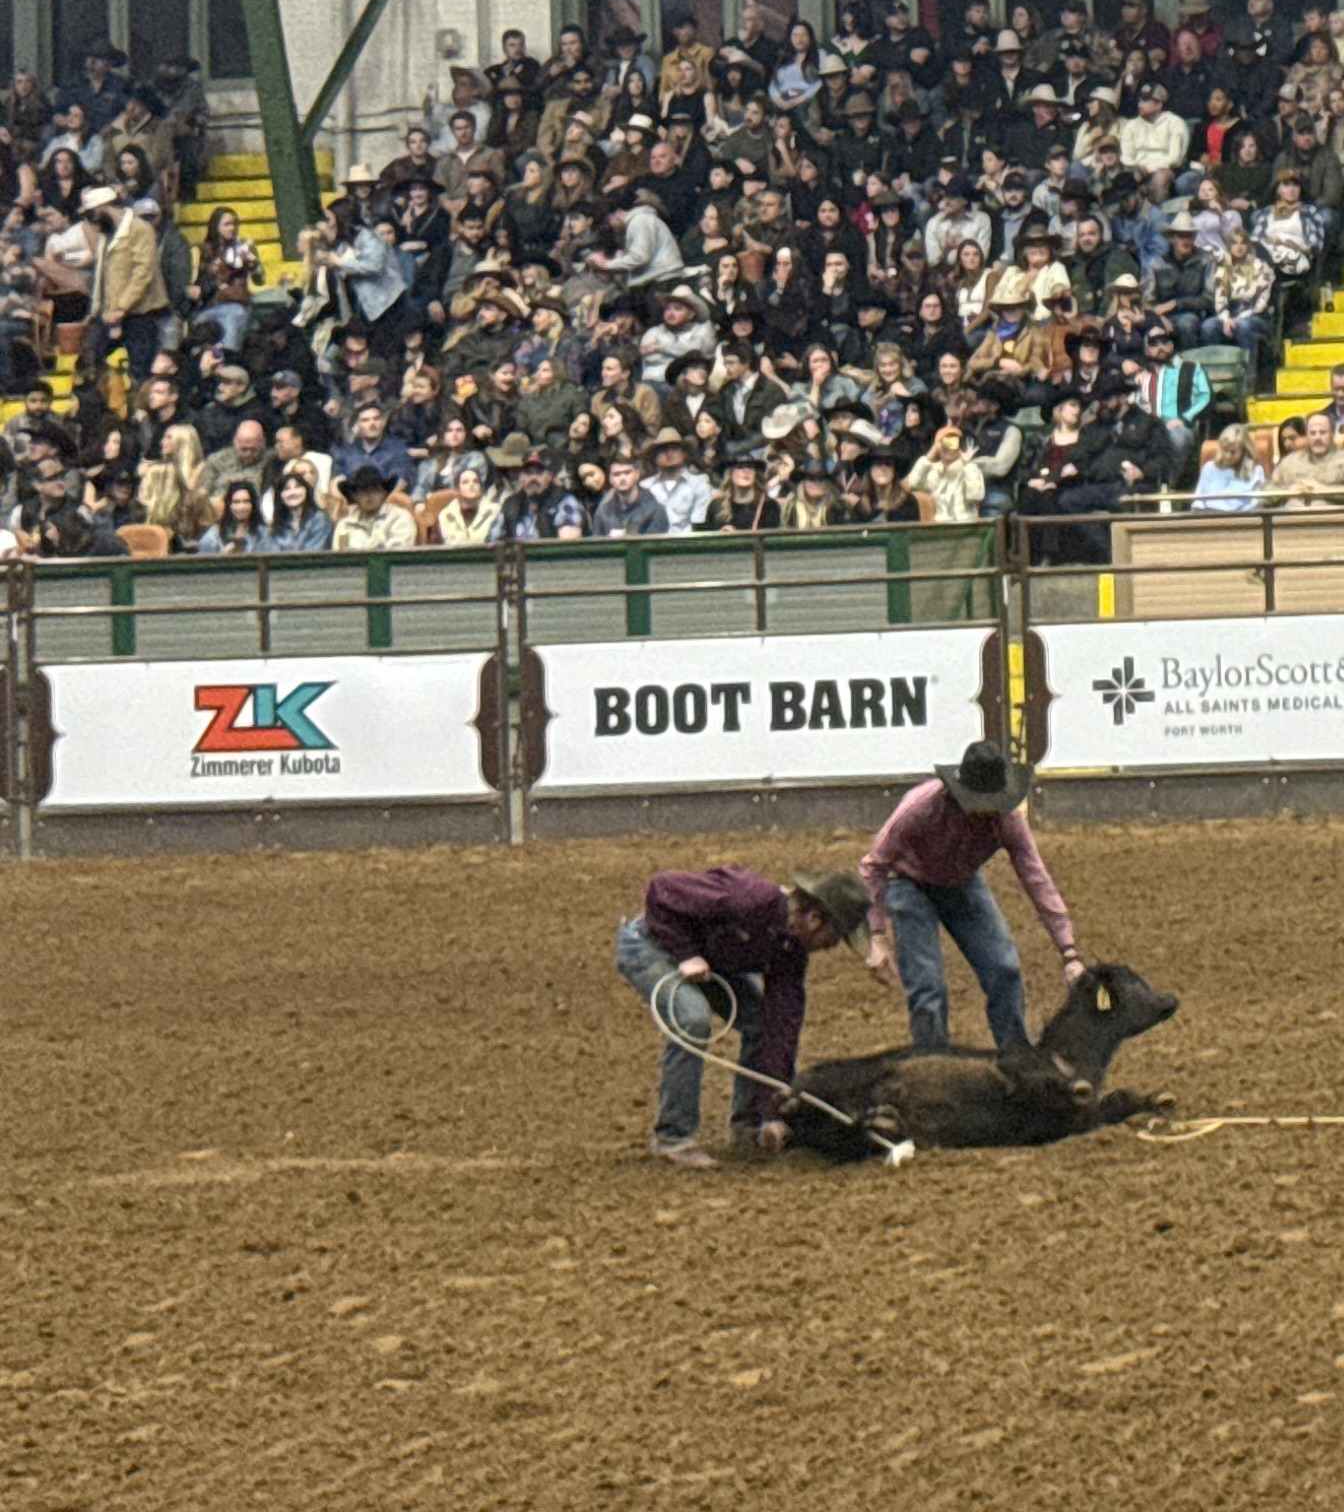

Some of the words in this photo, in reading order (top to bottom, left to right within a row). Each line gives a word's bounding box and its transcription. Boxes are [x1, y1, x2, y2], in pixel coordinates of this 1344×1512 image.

[192, 681, 339, 753] ZK
[594, 683, 750, 737] BOOT
[769, 676, 928, 731] BARN
[1164, 700, 1195, 715] ALL
[1200, 697, 1261, 713] SAINTS
[1267, 695, 1343, 712] MEDICAL
[1164, 725, 1195, 737] FORT
[191, 756, 273, 777] Zimmerer
[280, 753, 341, 775] Kubota
